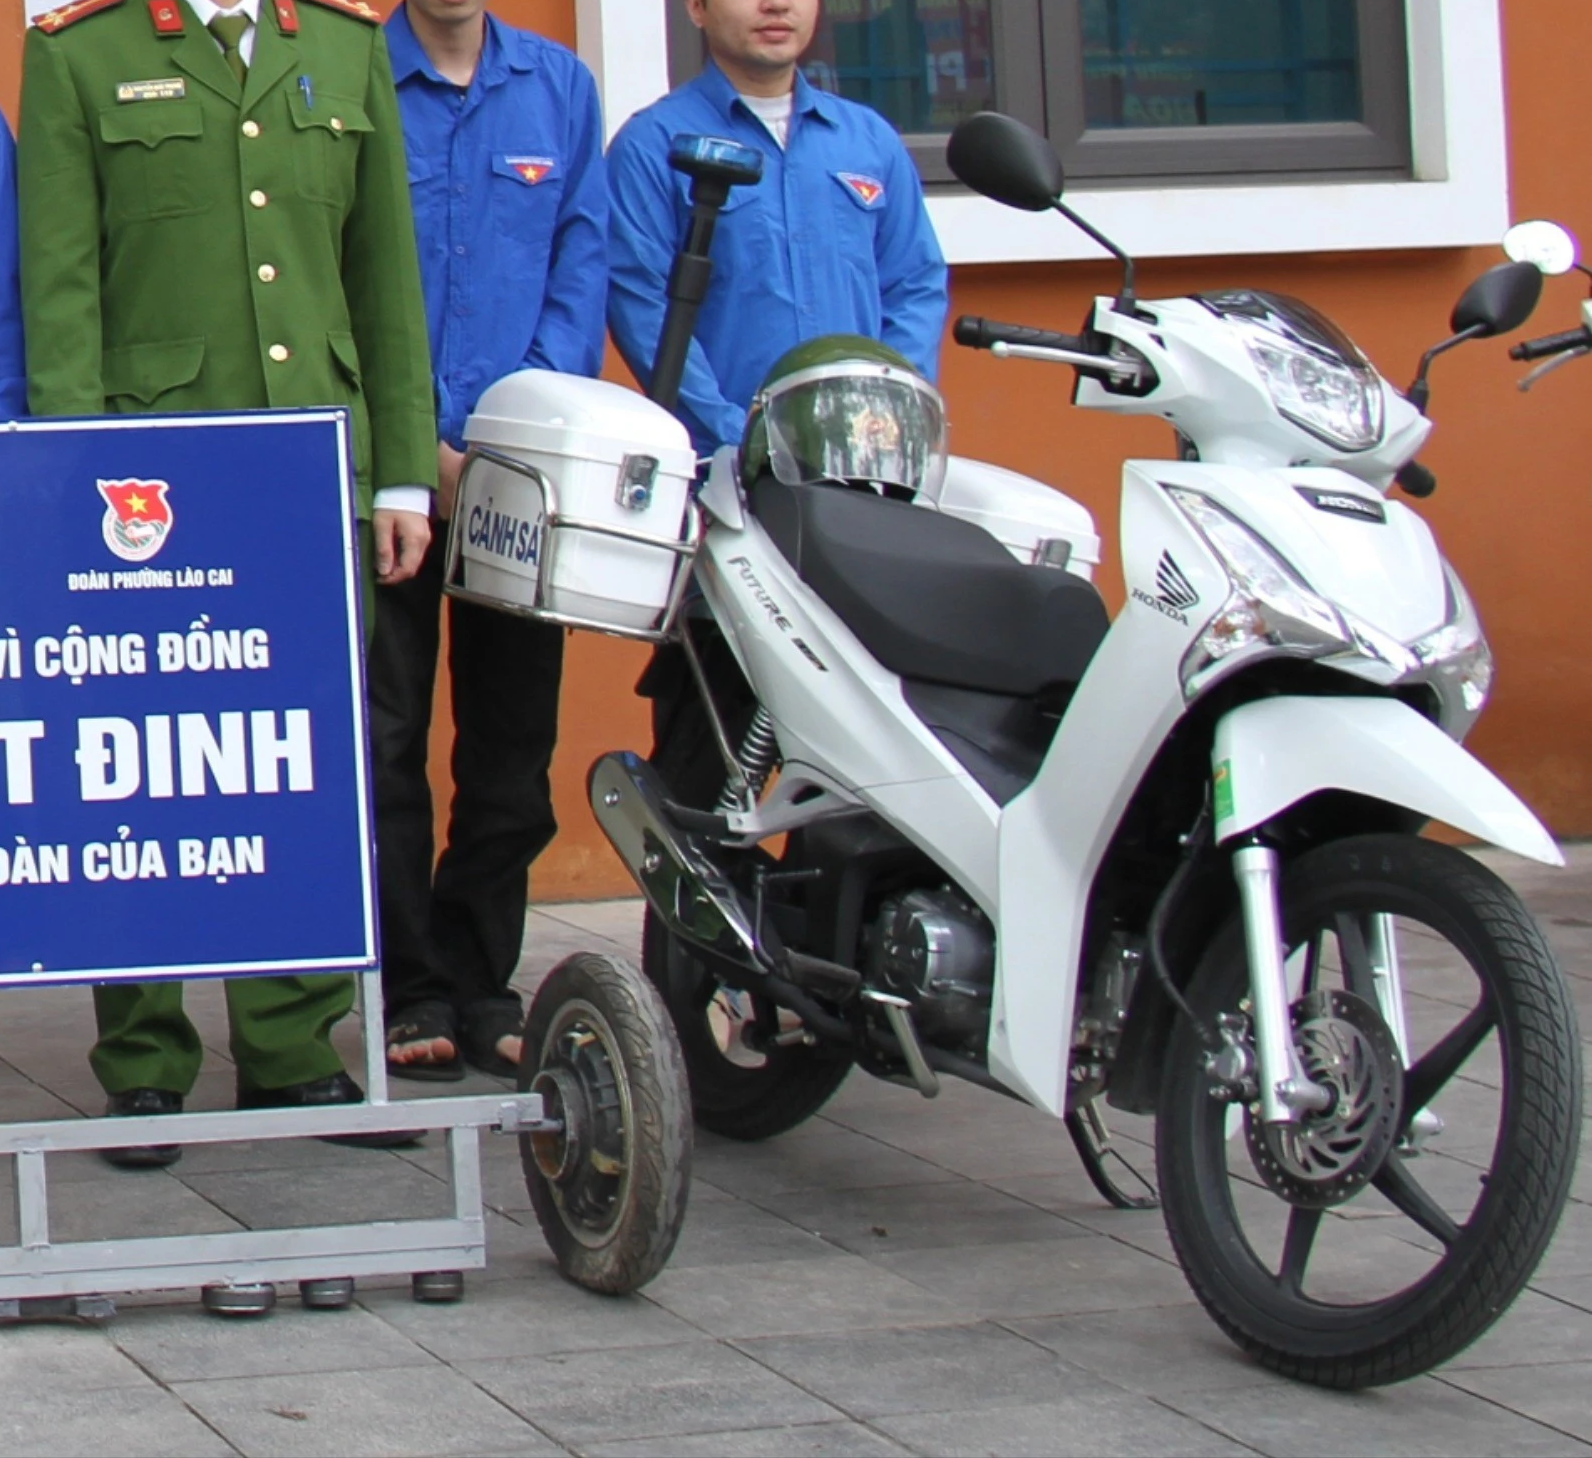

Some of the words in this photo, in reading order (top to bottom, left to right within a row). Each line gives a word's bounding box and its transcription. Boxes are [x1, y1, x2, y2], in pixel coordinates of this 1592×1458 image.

[469, 496, 518, 558] CẢNH
[69, 570, 109, 590] ĐOÀN
[113, 568, 173, 588] PHƯỜNG
[176, 567, 204, 587] LÀO
[208, 569, 233, 586] CAI
[727, 555, 793, 634] FUTURE
[1132, 587, 1188, 626] HONDA
[35, 626, 146, 684] CỘNG
[157, 615, 269, 672] ĐỒNG
[75, 710, 313, 800] ĐINH
[83, 826, 166, 881] CỦA
[179, 836, 264, 883] BẠN
